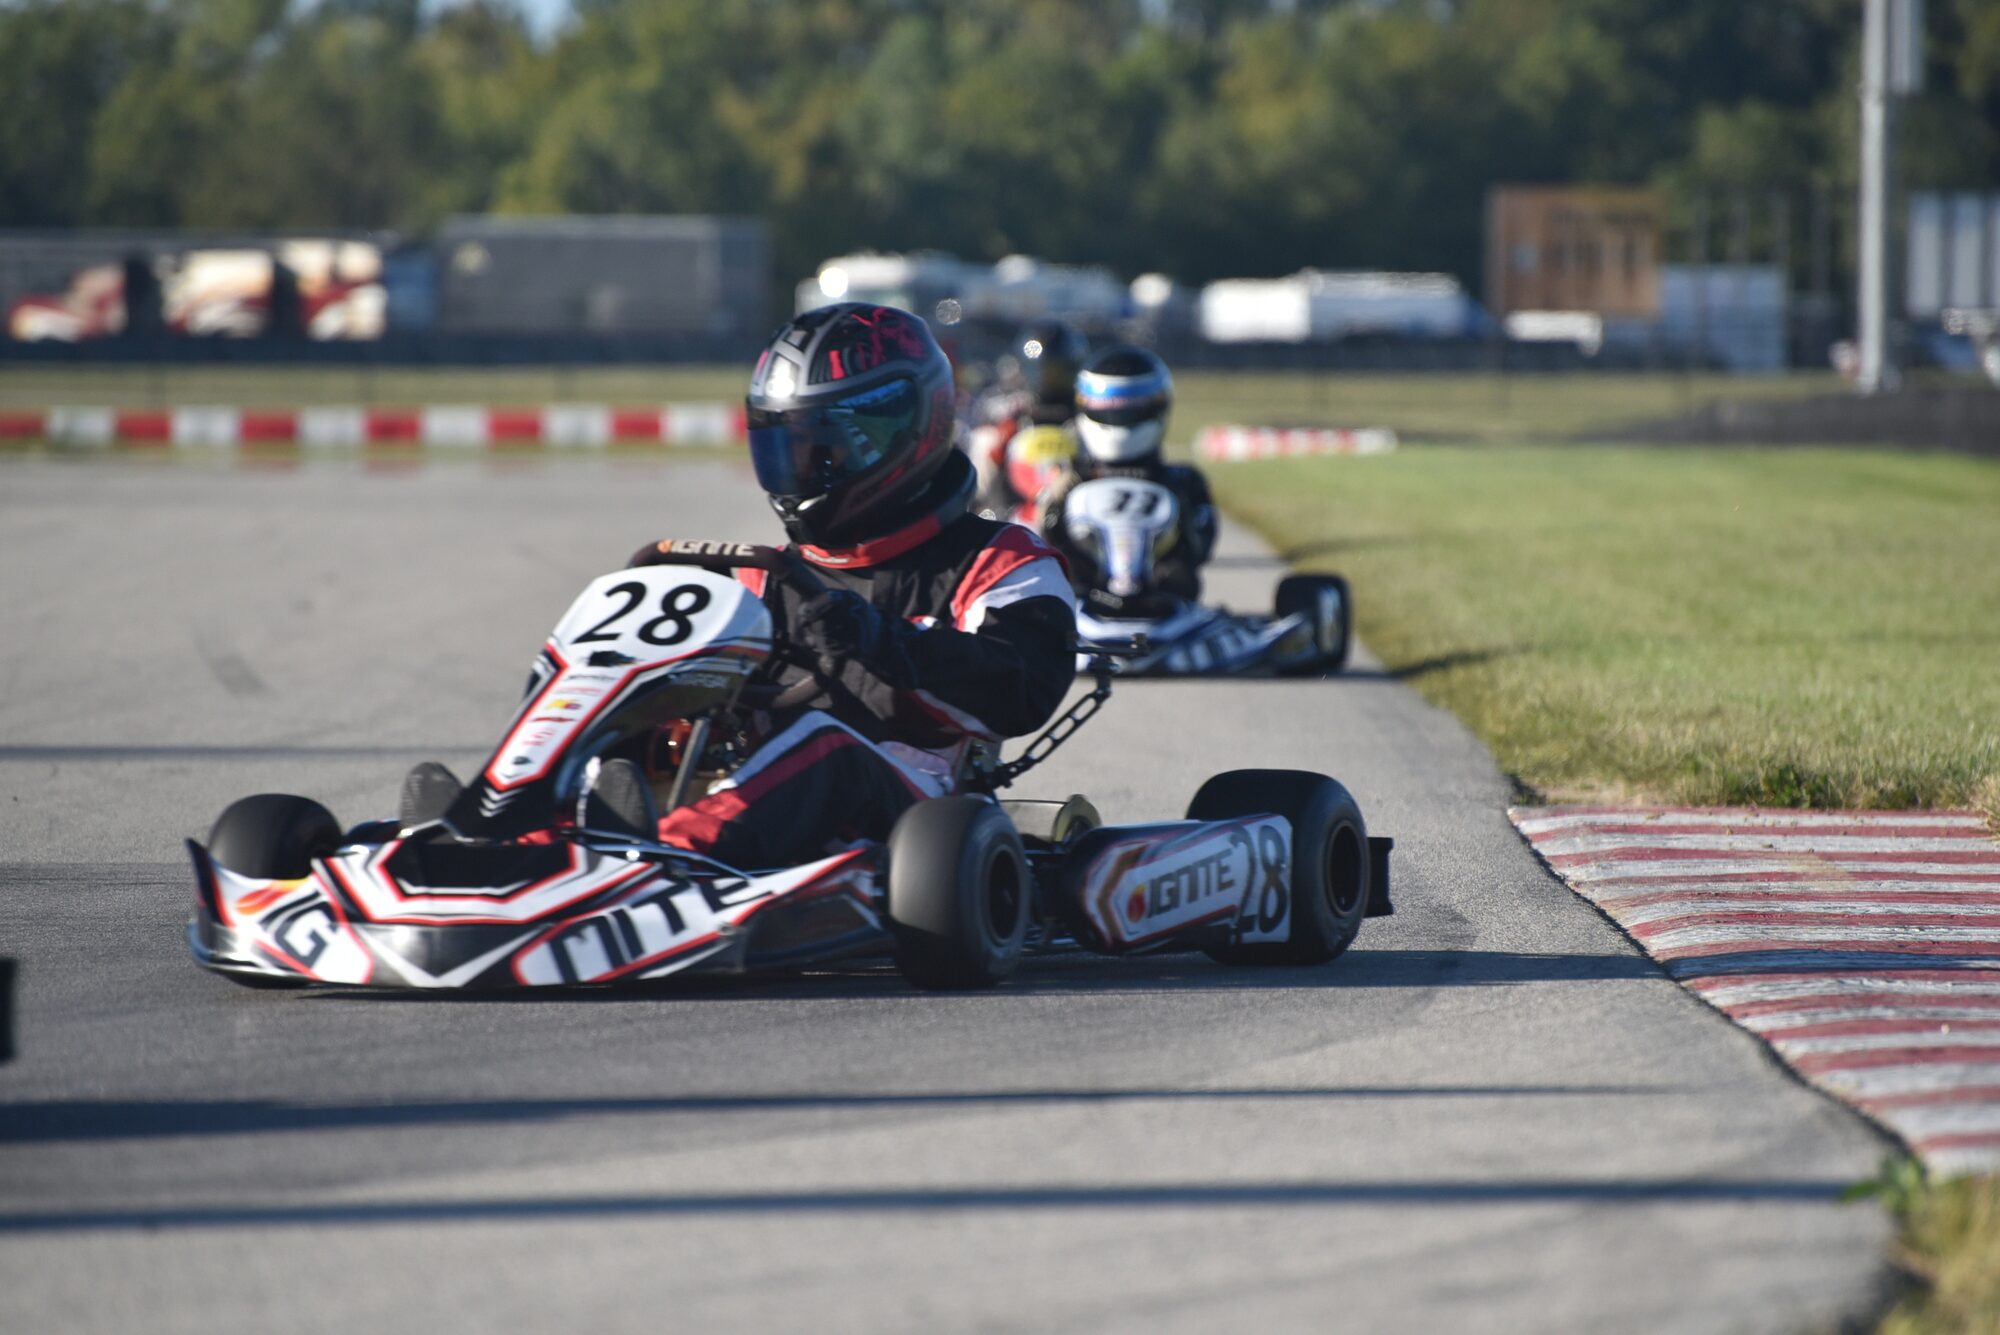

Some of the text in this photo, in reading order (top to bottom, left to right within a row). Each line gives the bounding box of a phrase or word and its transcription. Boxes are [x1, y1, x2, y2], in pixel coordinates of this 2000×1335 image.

[670, 540, 755, 556] IGNITE
[571, 581, 711, 646] 28
[1147, 848, 1236, 918] IGNITE
[1229, 824, 1290, 935] 28
